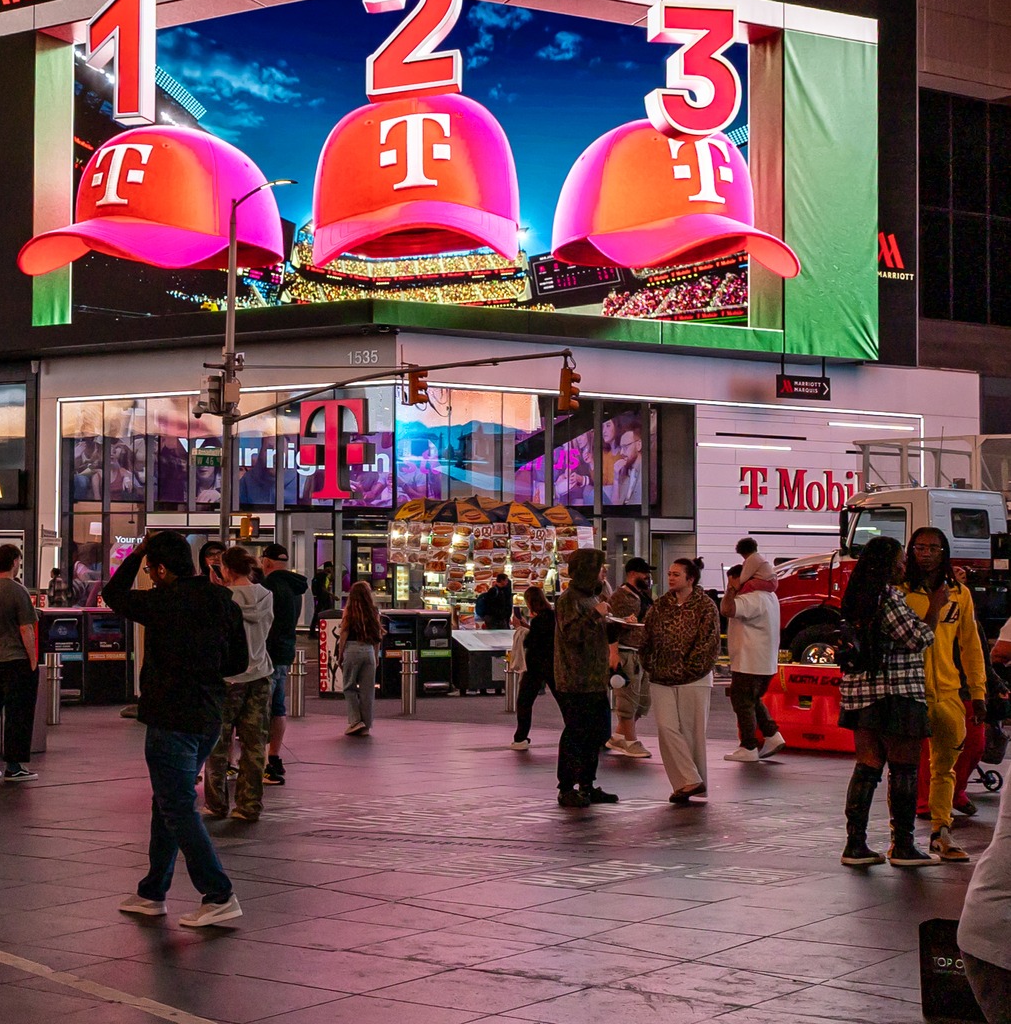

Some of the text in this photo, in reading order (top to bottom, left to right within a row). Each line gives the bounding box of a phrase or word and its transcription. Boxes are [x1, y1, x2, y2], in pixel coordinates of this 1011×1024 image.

[644, 2, 743, 139] 3
[91, 143, 153, 207] T
[379, 112, 452, 192] T
[668, 134, 734, 204] T
[347, 350, 379, 364] 1535
[197, 455, 215, 466] W 46
[300, 398, 368, 500] T
[740, 466, 860, 512] T Mobi
[319, 619, 328, 692] CHICAGO
